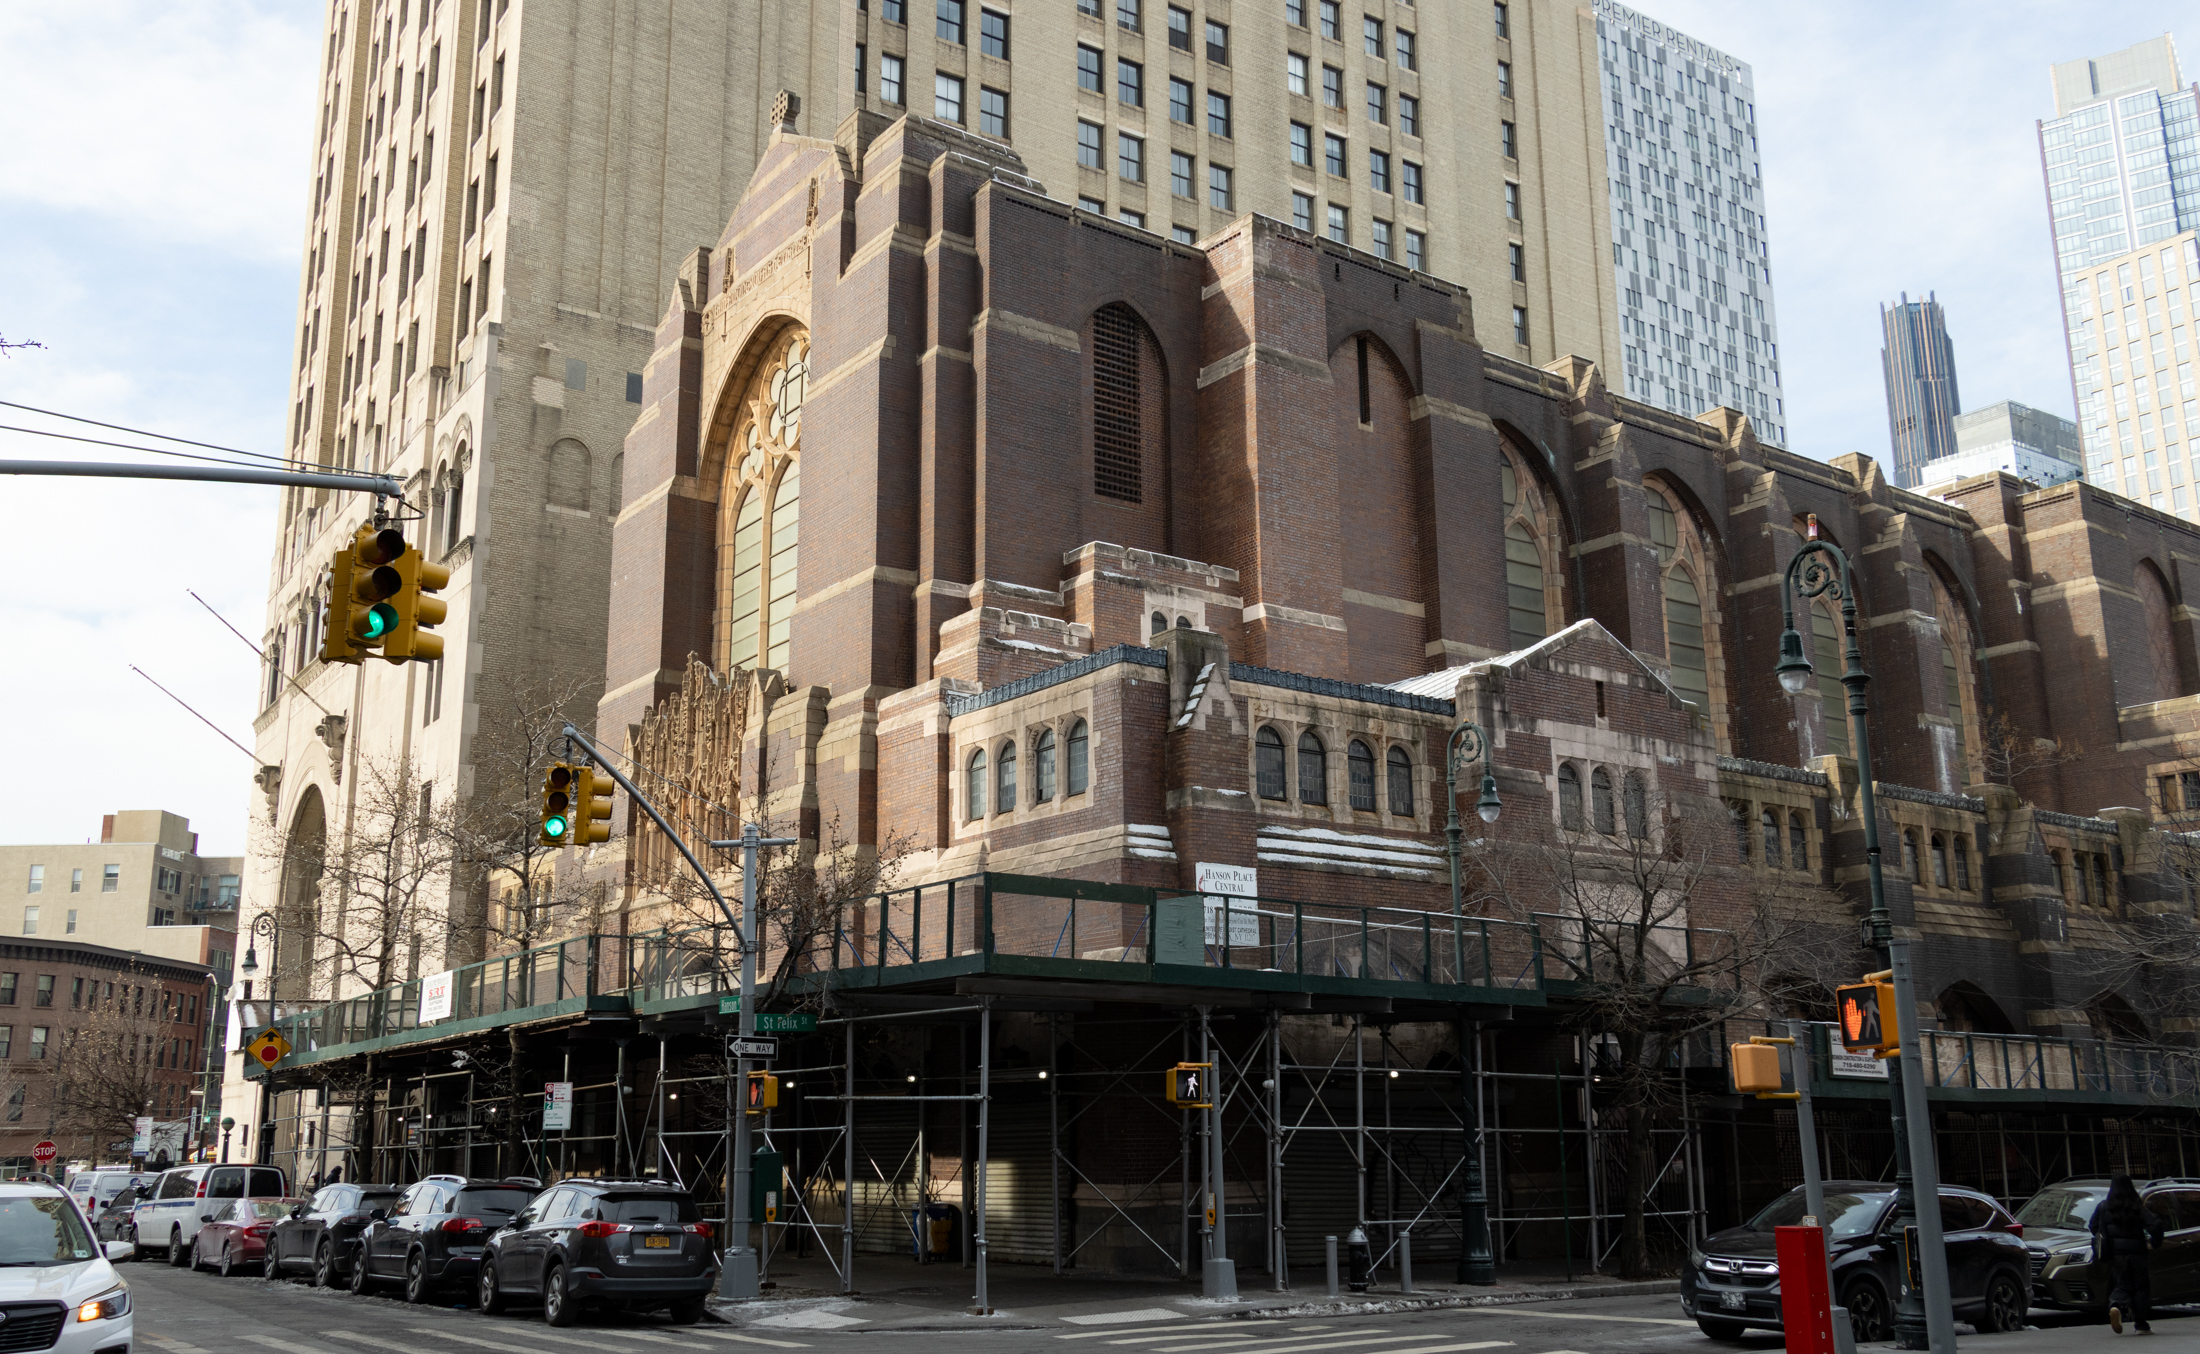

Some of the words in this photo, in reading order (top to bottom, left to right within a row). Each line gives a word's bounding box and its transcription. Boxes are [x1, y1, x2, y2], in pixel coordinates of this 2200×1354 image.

[1592, 0, 1661, 39] PREMIER
[1666, 27, 1734, 72] RENTALS
[1205, 869, 1231, 880] HANSON
[1233, 871, 1254, 882] PLACE
[1214, 880, 1245, 892] CENTRAL
[763, 1016, 773, 1030] St
[777, 1016, 798, 1030] Felix
[801, 1016, 808, 1025] St
[734, 1042, 749, 1052] ONE
[755, 1044, 772, 1053] WAY
[35, 1147, 56, 1156] STOP
